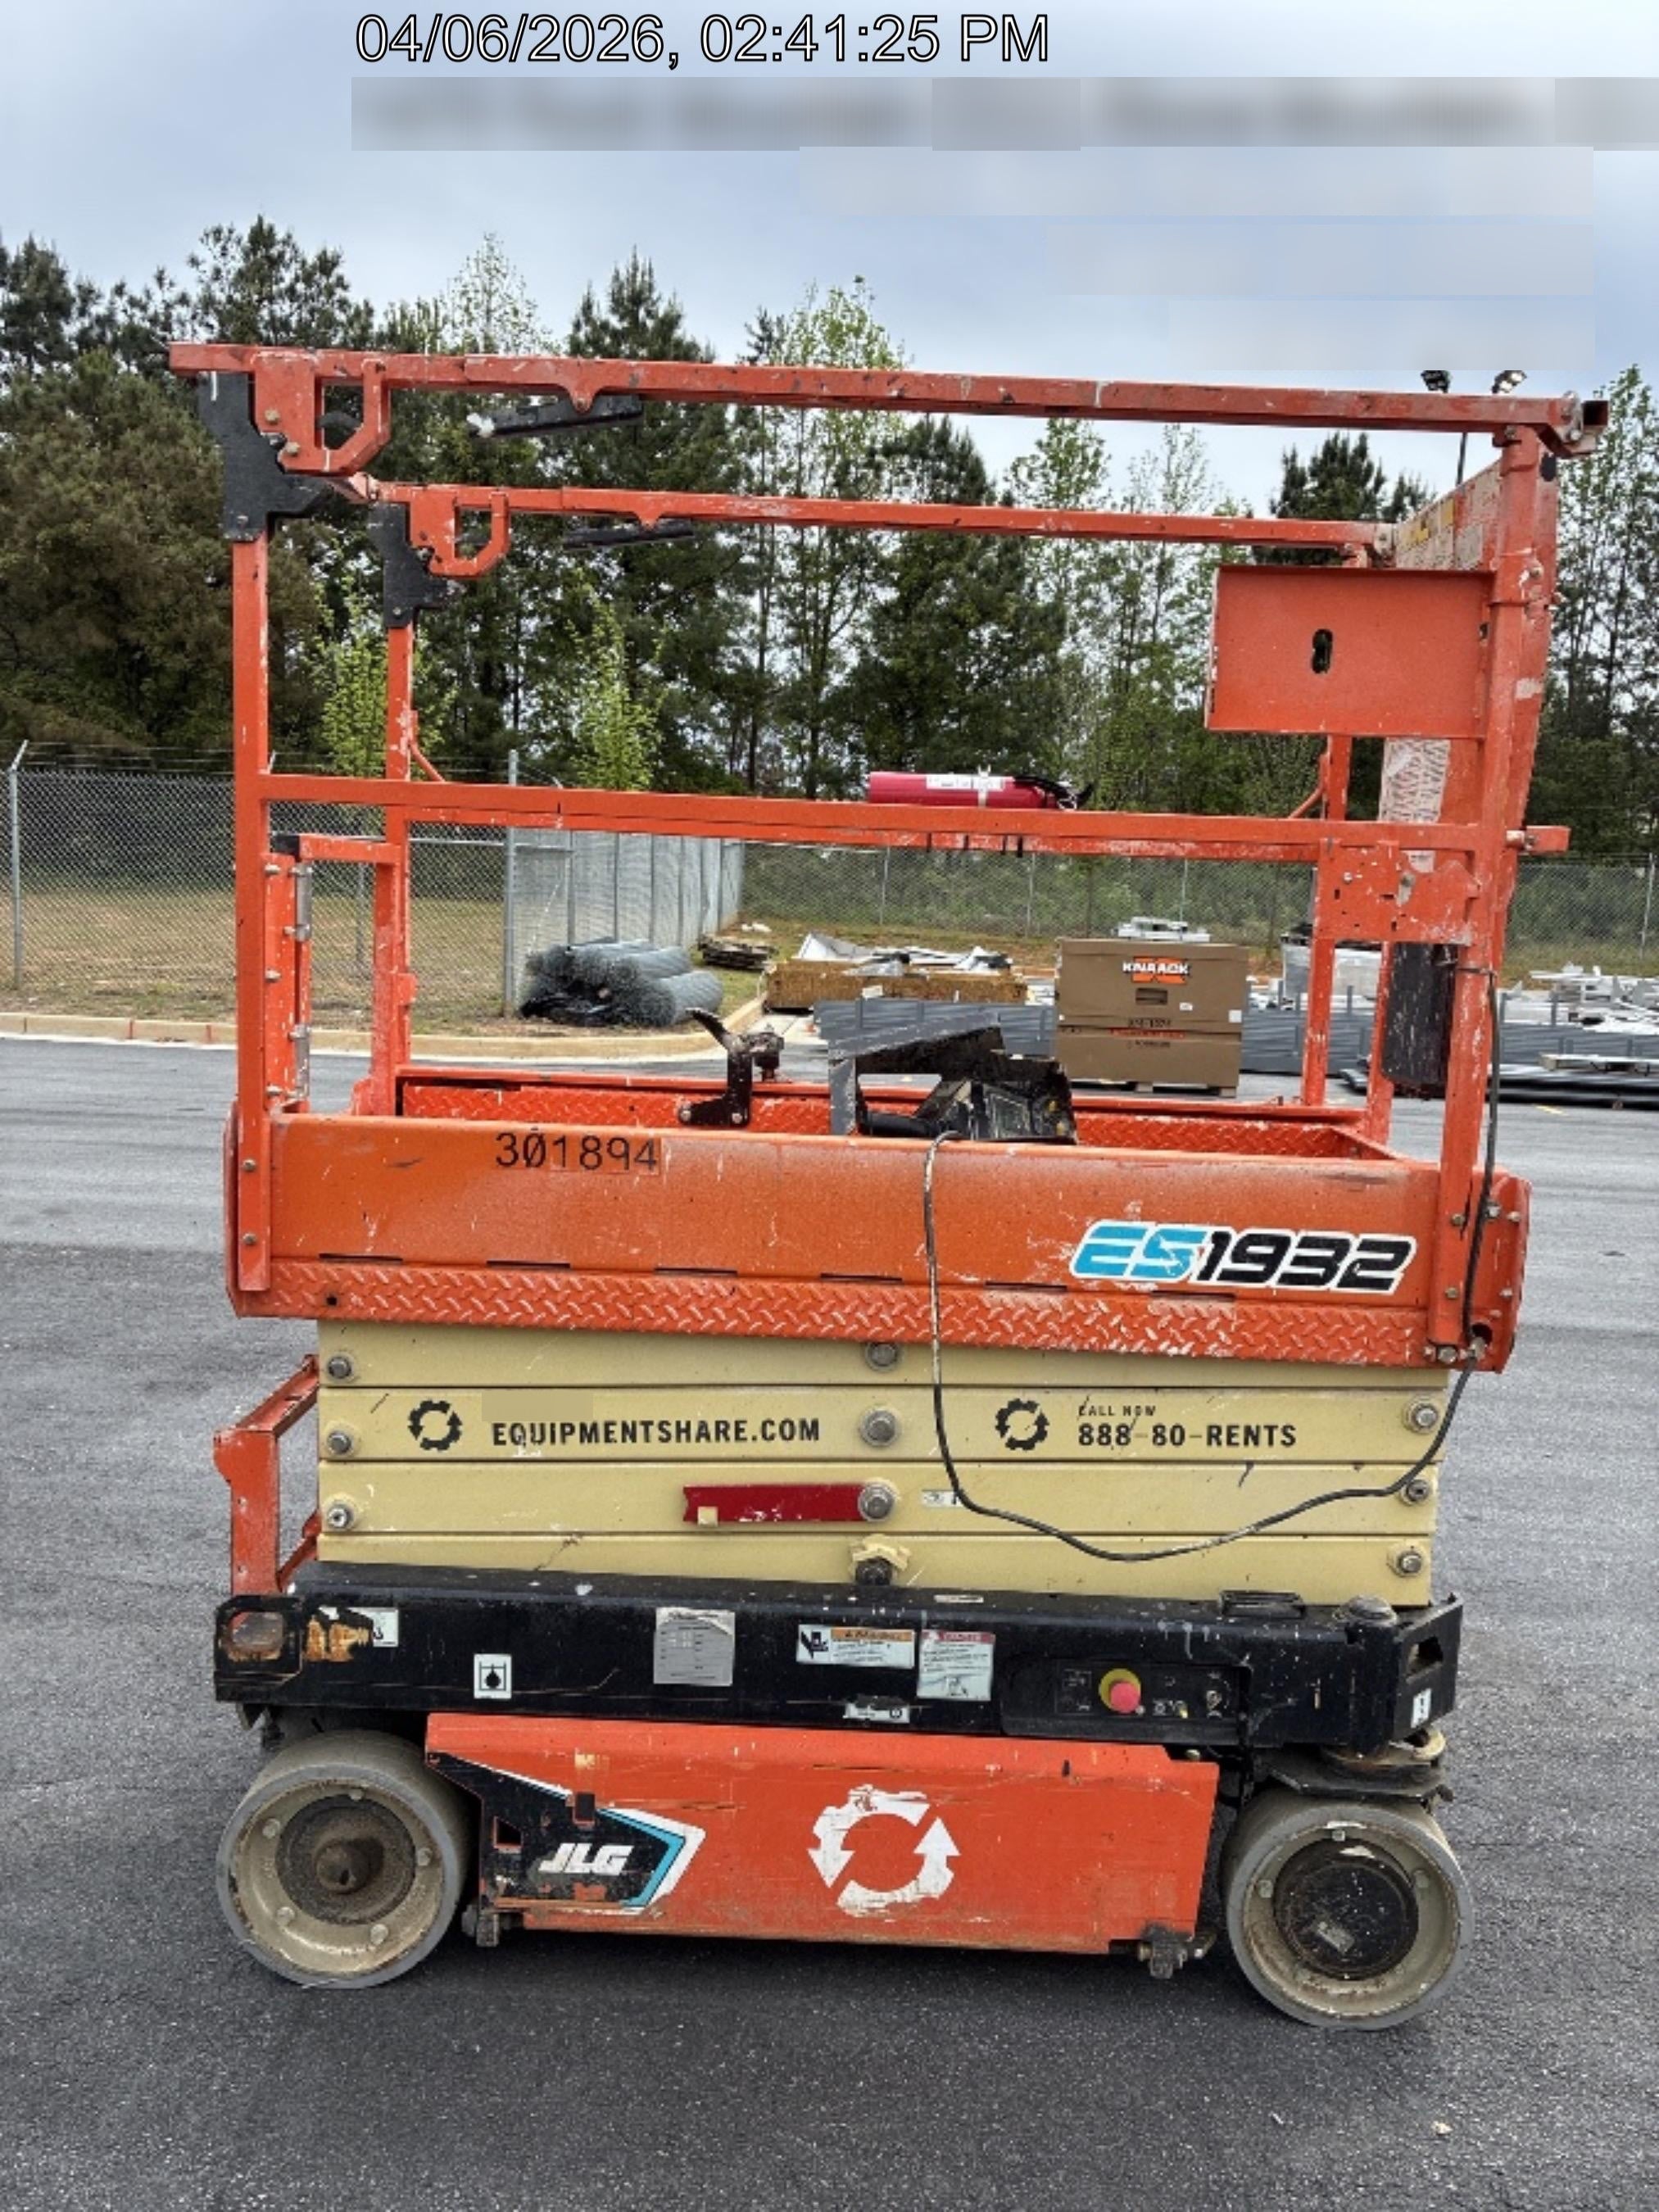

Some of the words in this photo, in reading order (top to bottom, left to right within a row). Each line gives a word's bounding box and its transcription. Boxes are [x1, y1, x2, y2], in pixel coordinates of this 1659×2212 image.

[496, 1132, 658, 1171] 301894
[1073, 1223, 1413, 1293] ES1932
[1078, 1404, 1115, 1416] CALL
[1122, 1404, 1157, 1416] NOW
[492, 1417, 820, 1448] EQUIPMENTSHARE.COM
[537, 1842, 634, 1877] JLG
